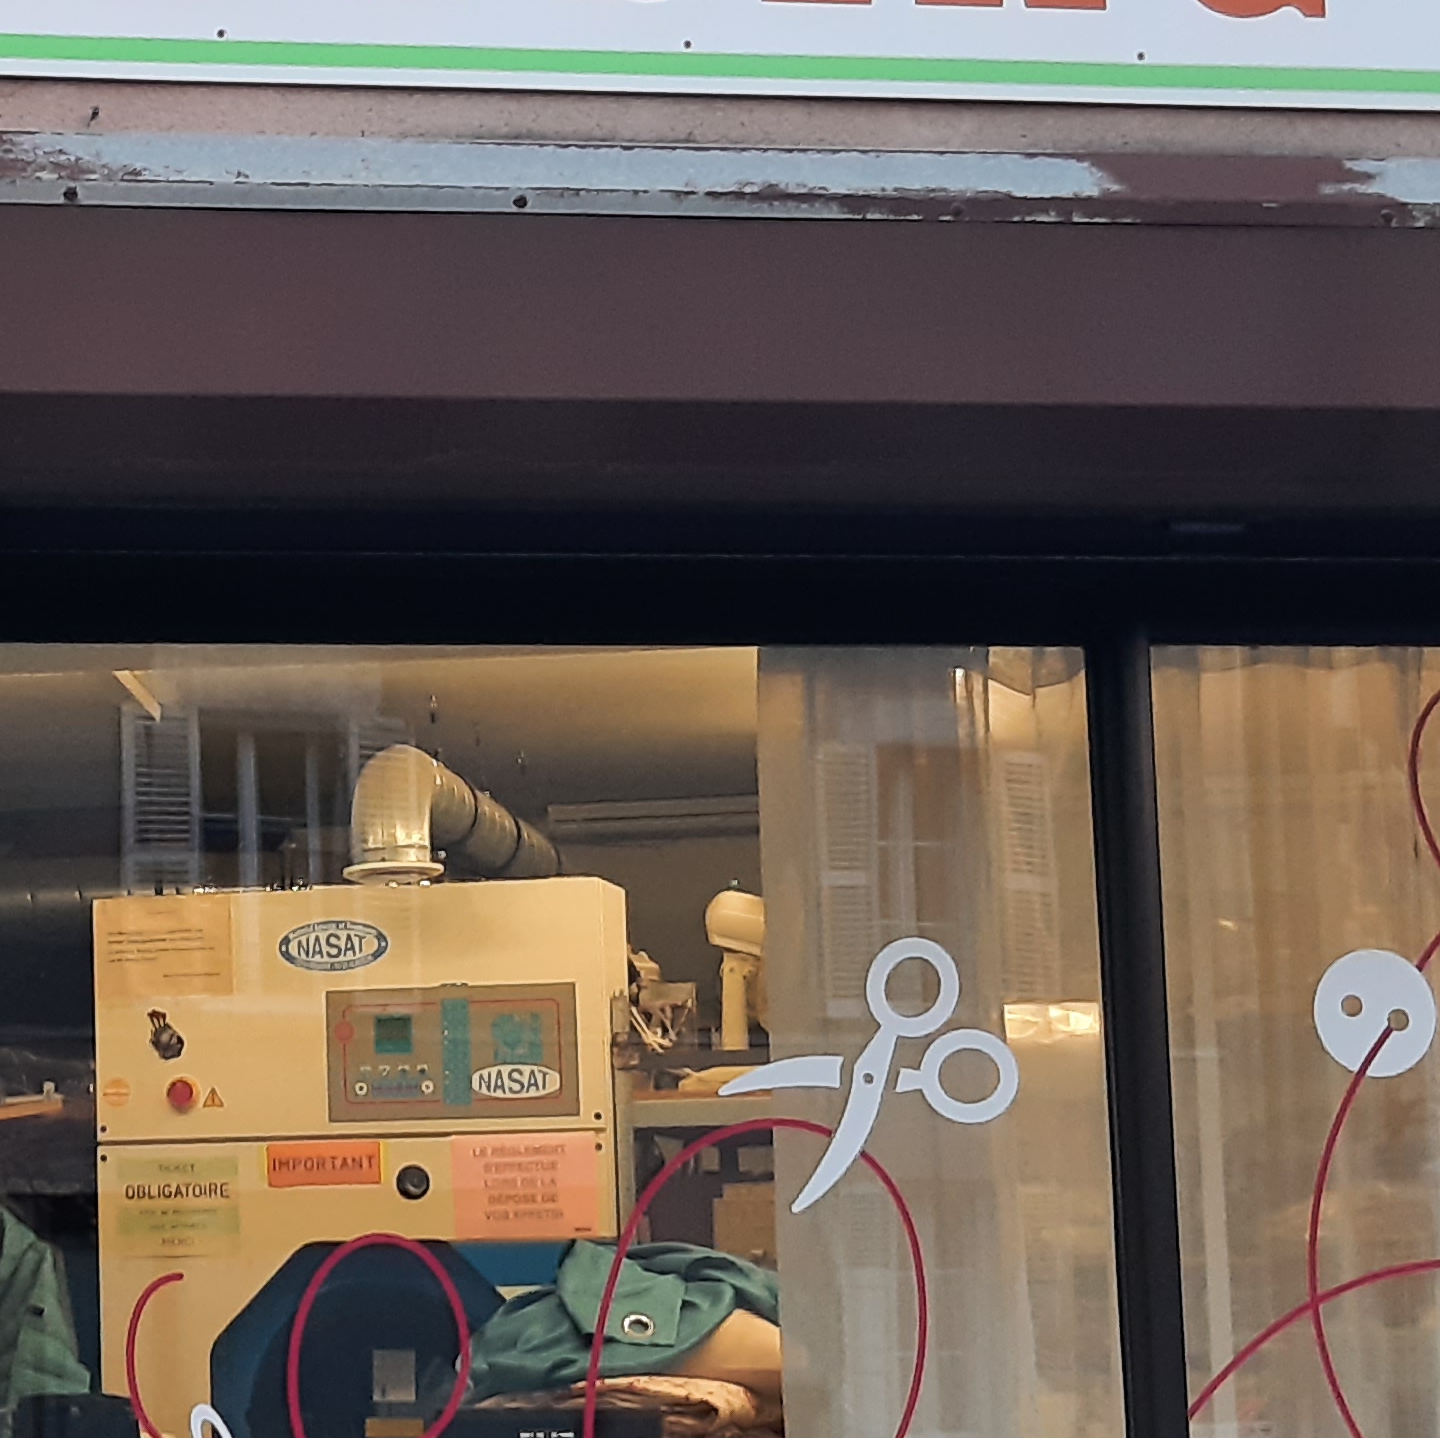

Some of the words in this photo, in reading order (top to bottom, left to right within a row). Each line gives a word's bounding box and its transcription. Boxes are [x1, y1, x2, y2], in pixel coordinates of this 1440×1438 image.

[297, 932, 367, 959] NASAT
[478, 1068, 549, 1095] NASAT
[271, 1154, 376, 1174] IMPORTANT
[124, 1182, 231, 1200] OBLIGATOIRE
